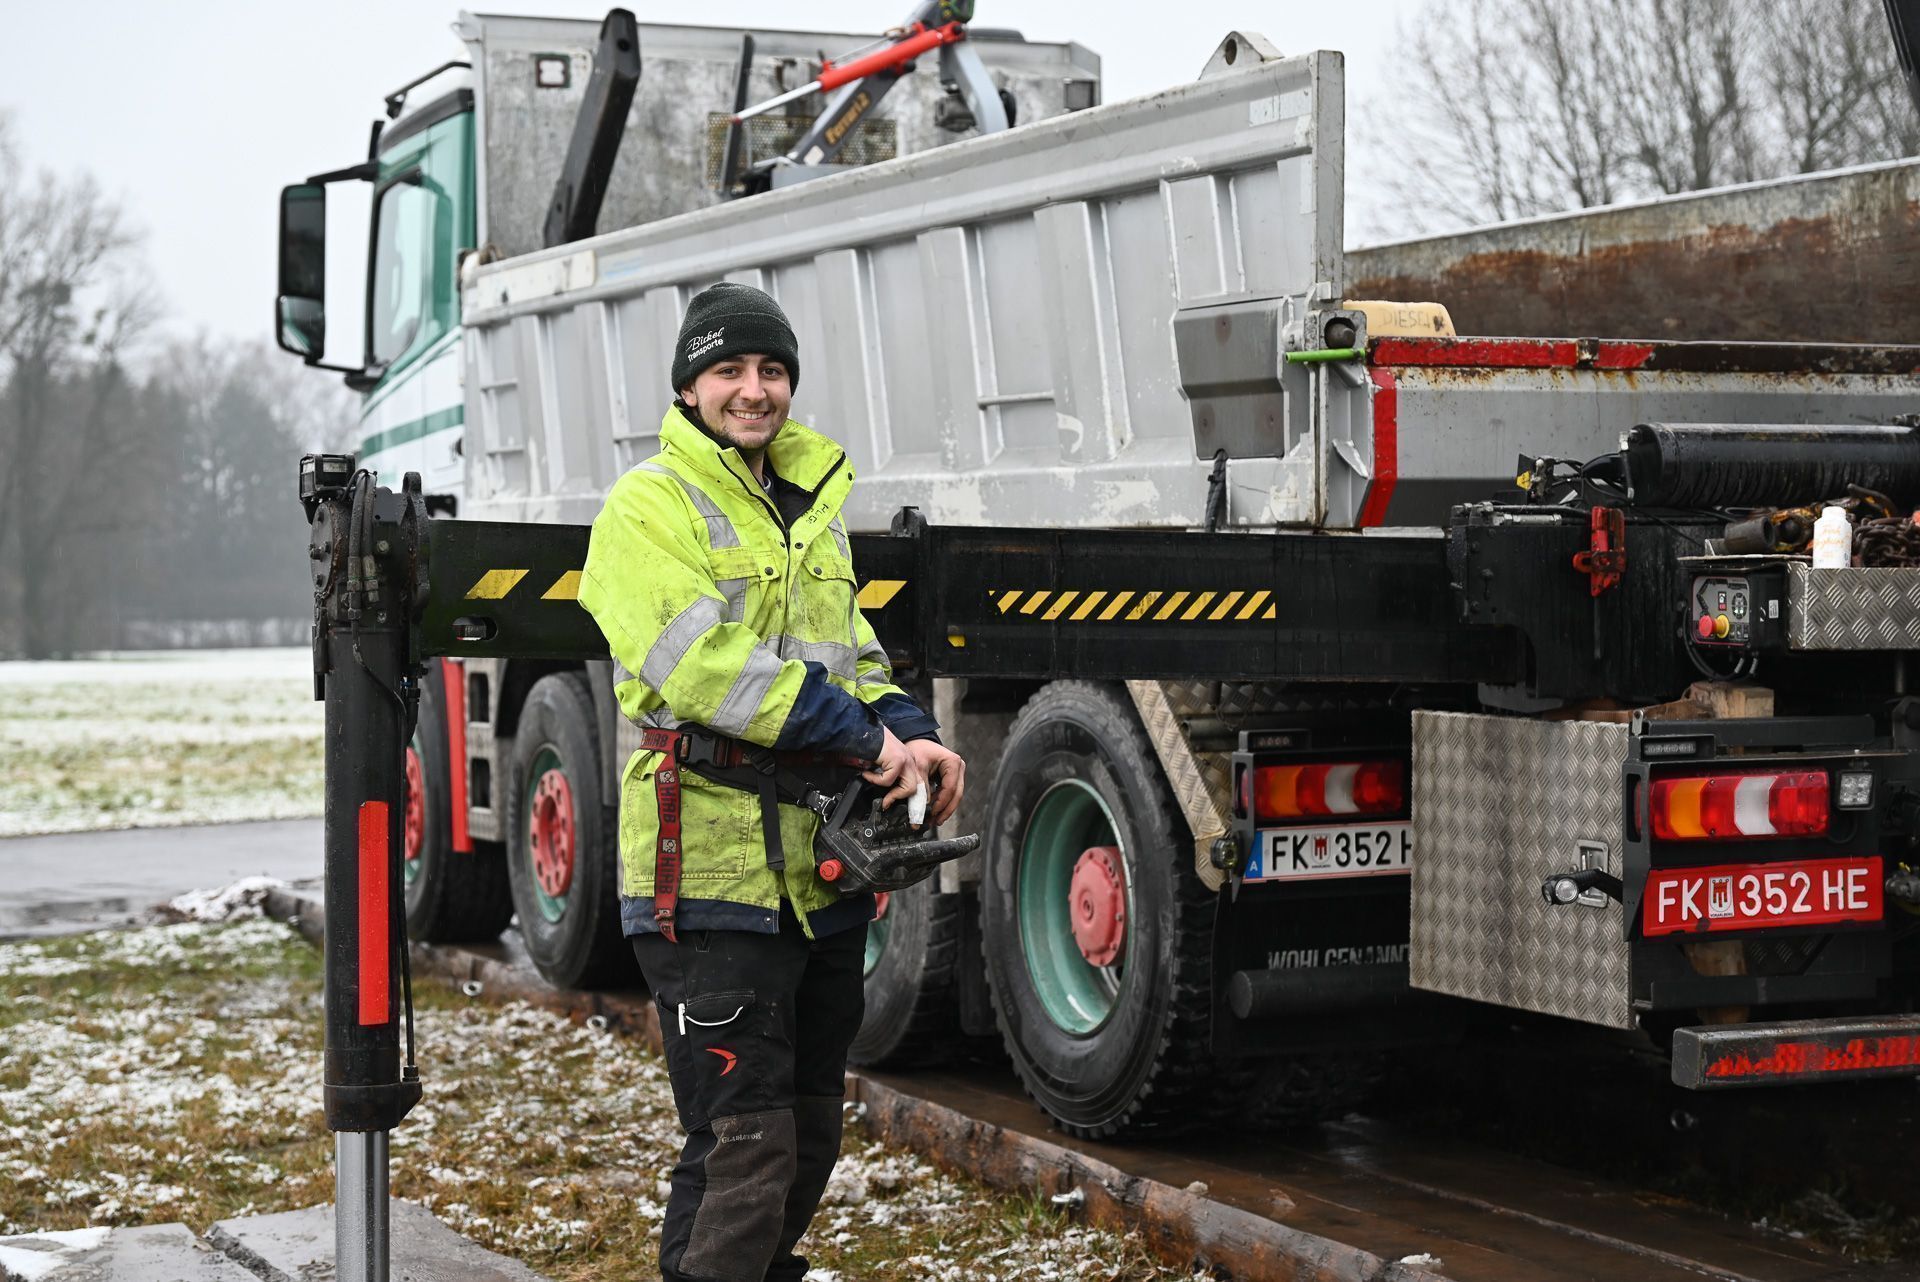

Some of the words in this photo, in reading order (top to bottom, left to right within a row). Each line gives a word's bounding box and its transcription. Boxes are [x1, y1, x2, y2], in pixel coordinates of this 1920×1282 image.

[1378, 308, 1431, 329] DIESEL
[685, 327, 725, 351] Bickel
[687, 338, 724, 362] Transporte
[660, 786, 677, 823] HIAB
[1272, 834, 1309, 871] FK
[1335, 830, 1391, 868] 352
[661, 856, 676, 894] HIAB
[1250, 860, 1258, 871] A
[1658, 878, 1704, 923] FK
[1738, 871, 1812, 917] 352
[1822, 868, 1869, 912] HE
[1269, 944, 1411, 969] WOHLGENANN
